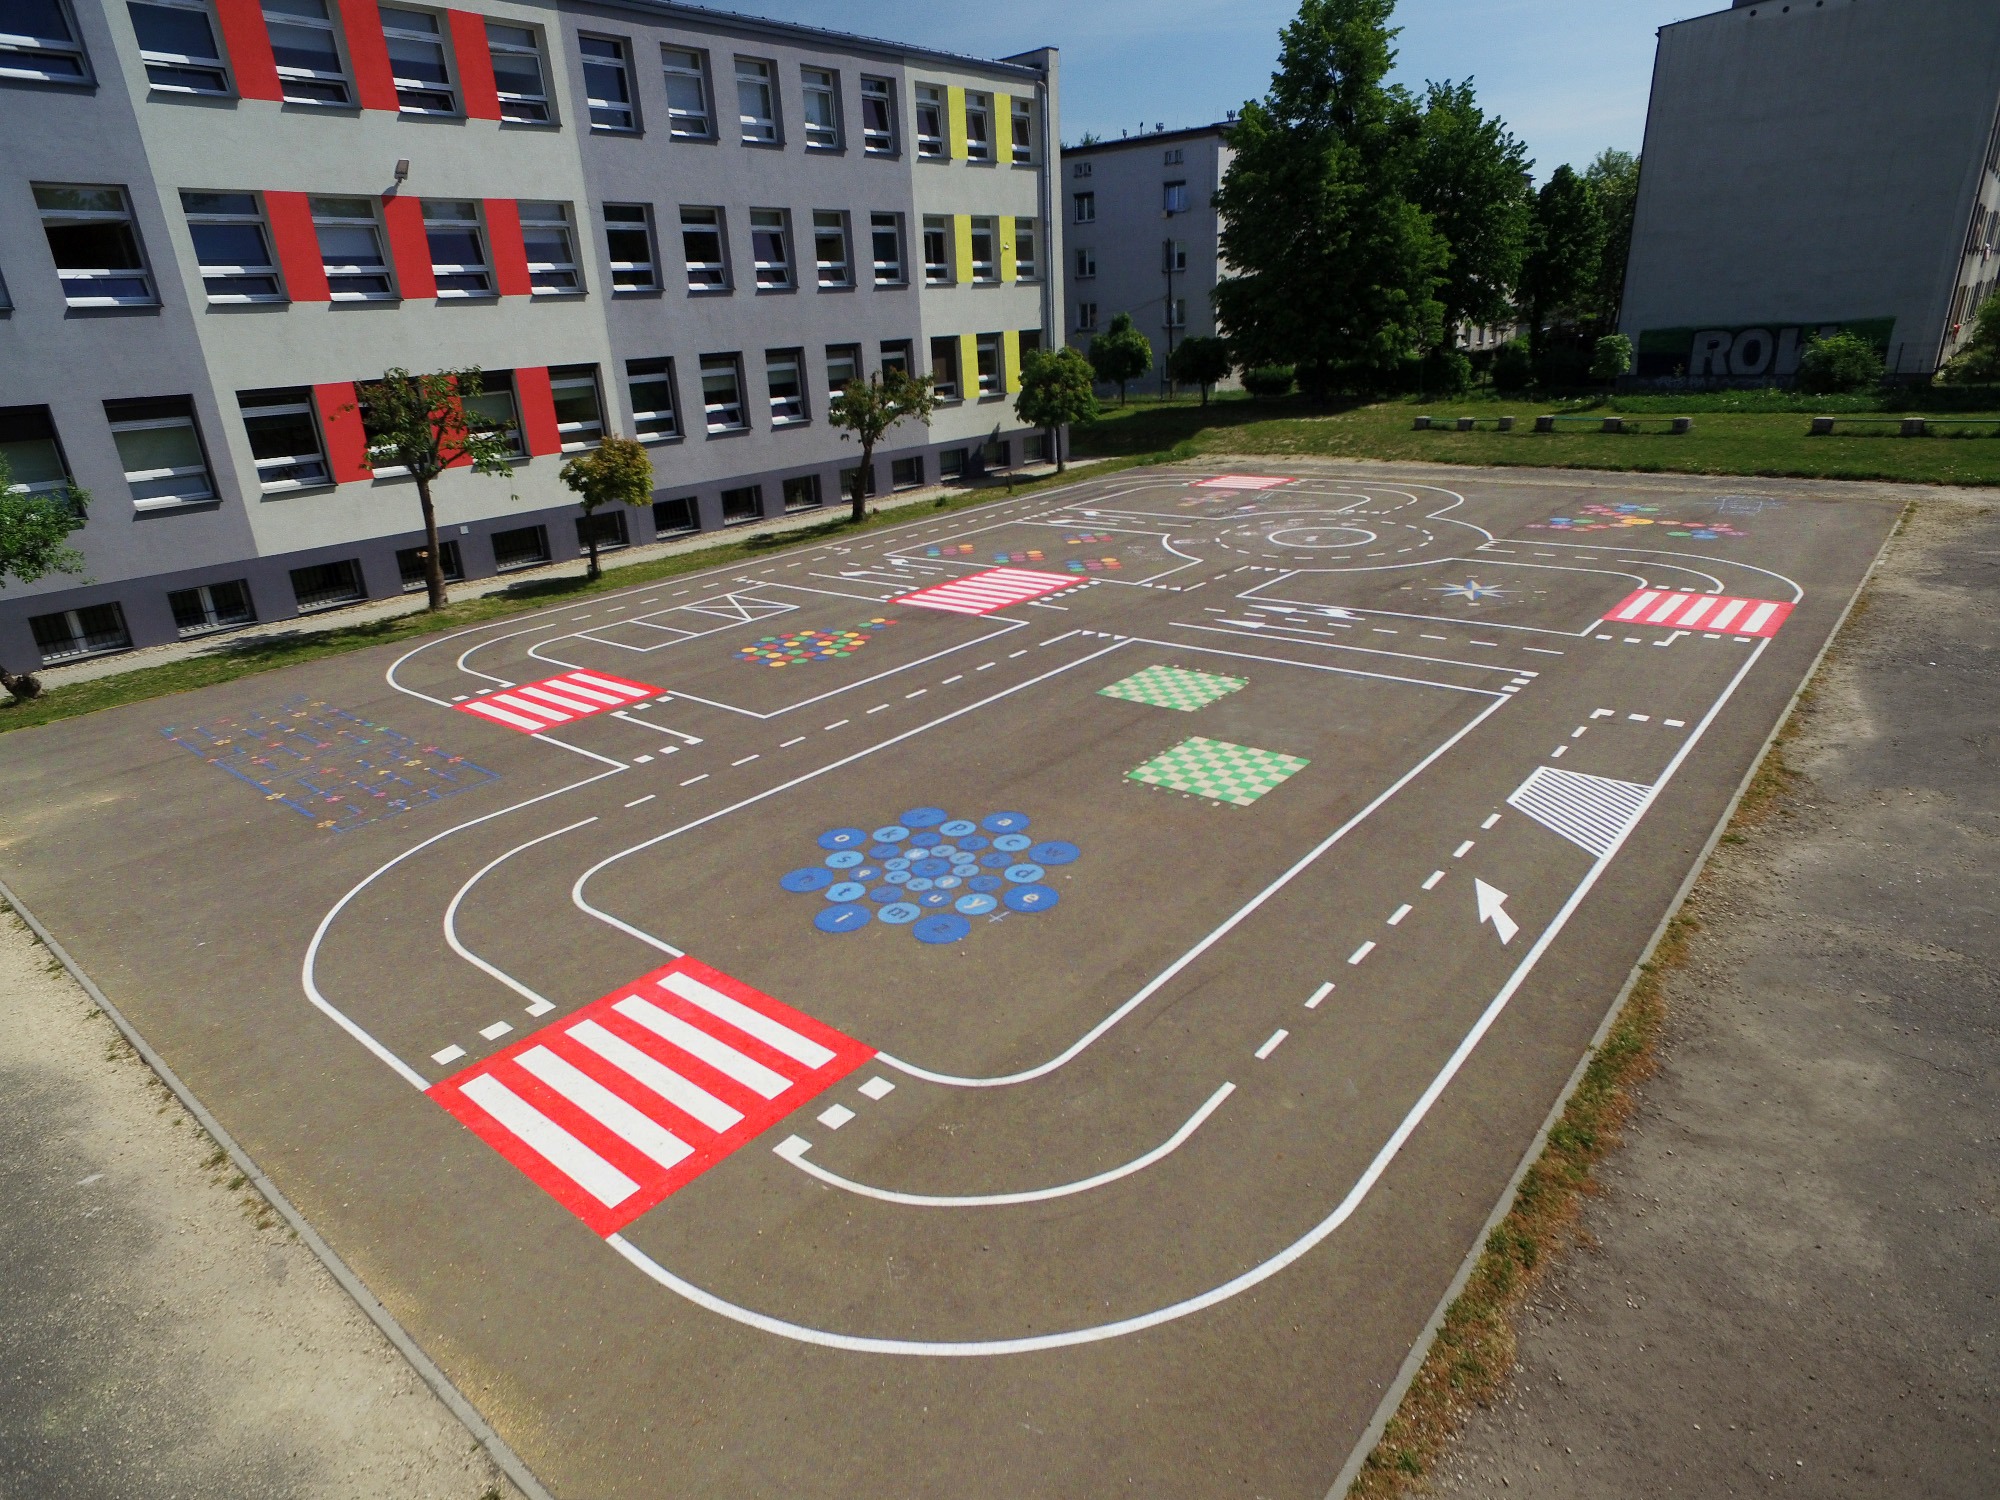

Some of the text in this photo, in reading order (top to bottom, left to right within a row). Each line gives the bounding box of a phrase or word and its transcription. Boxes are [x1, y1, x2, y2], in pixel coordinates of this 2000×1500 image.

[948, 823, 967, 833] p
[881, 828, 899, 840] k
[1006, 838, 1020, 847] c
[837, 855, 851, 863] s
[1015, 870, 1036, 879] d
[1023, 892, 1040, 902] e
[963, 898, 988, 909] y
[835, 912, 853, 923] i
[887, 907, 909, 920] m
